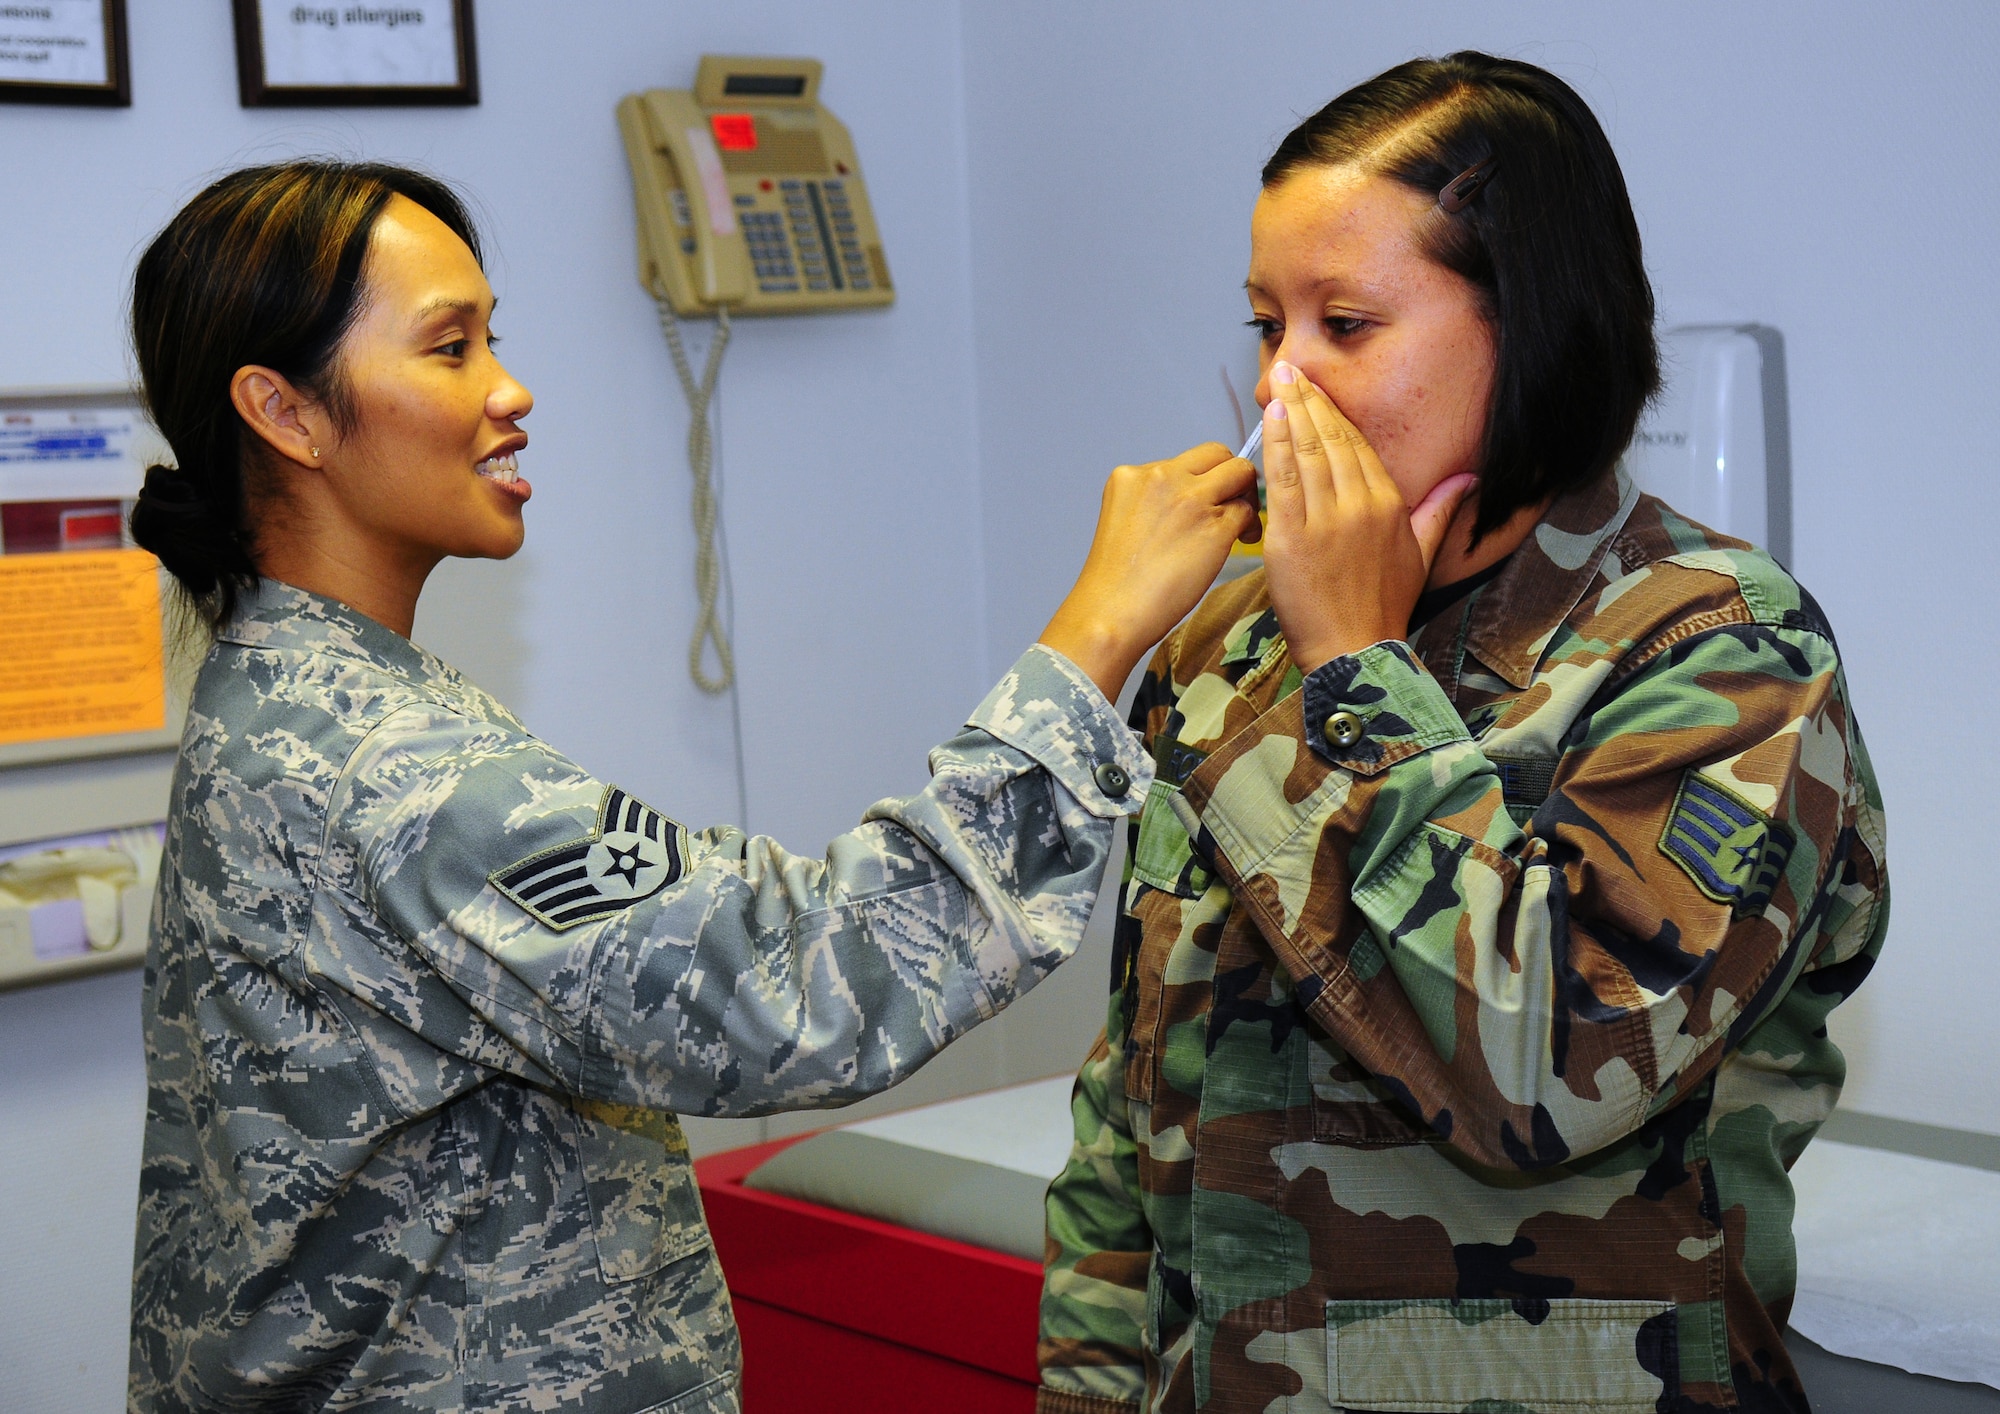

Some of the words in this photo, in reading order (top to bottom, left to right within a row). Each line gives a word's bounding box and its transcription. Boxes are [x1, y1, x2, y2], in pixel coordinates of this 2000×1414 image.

[290, 6, 338, 29] drug
[343, 5, 425, 29] allergies
[1502, 764, 1521, 796] E
